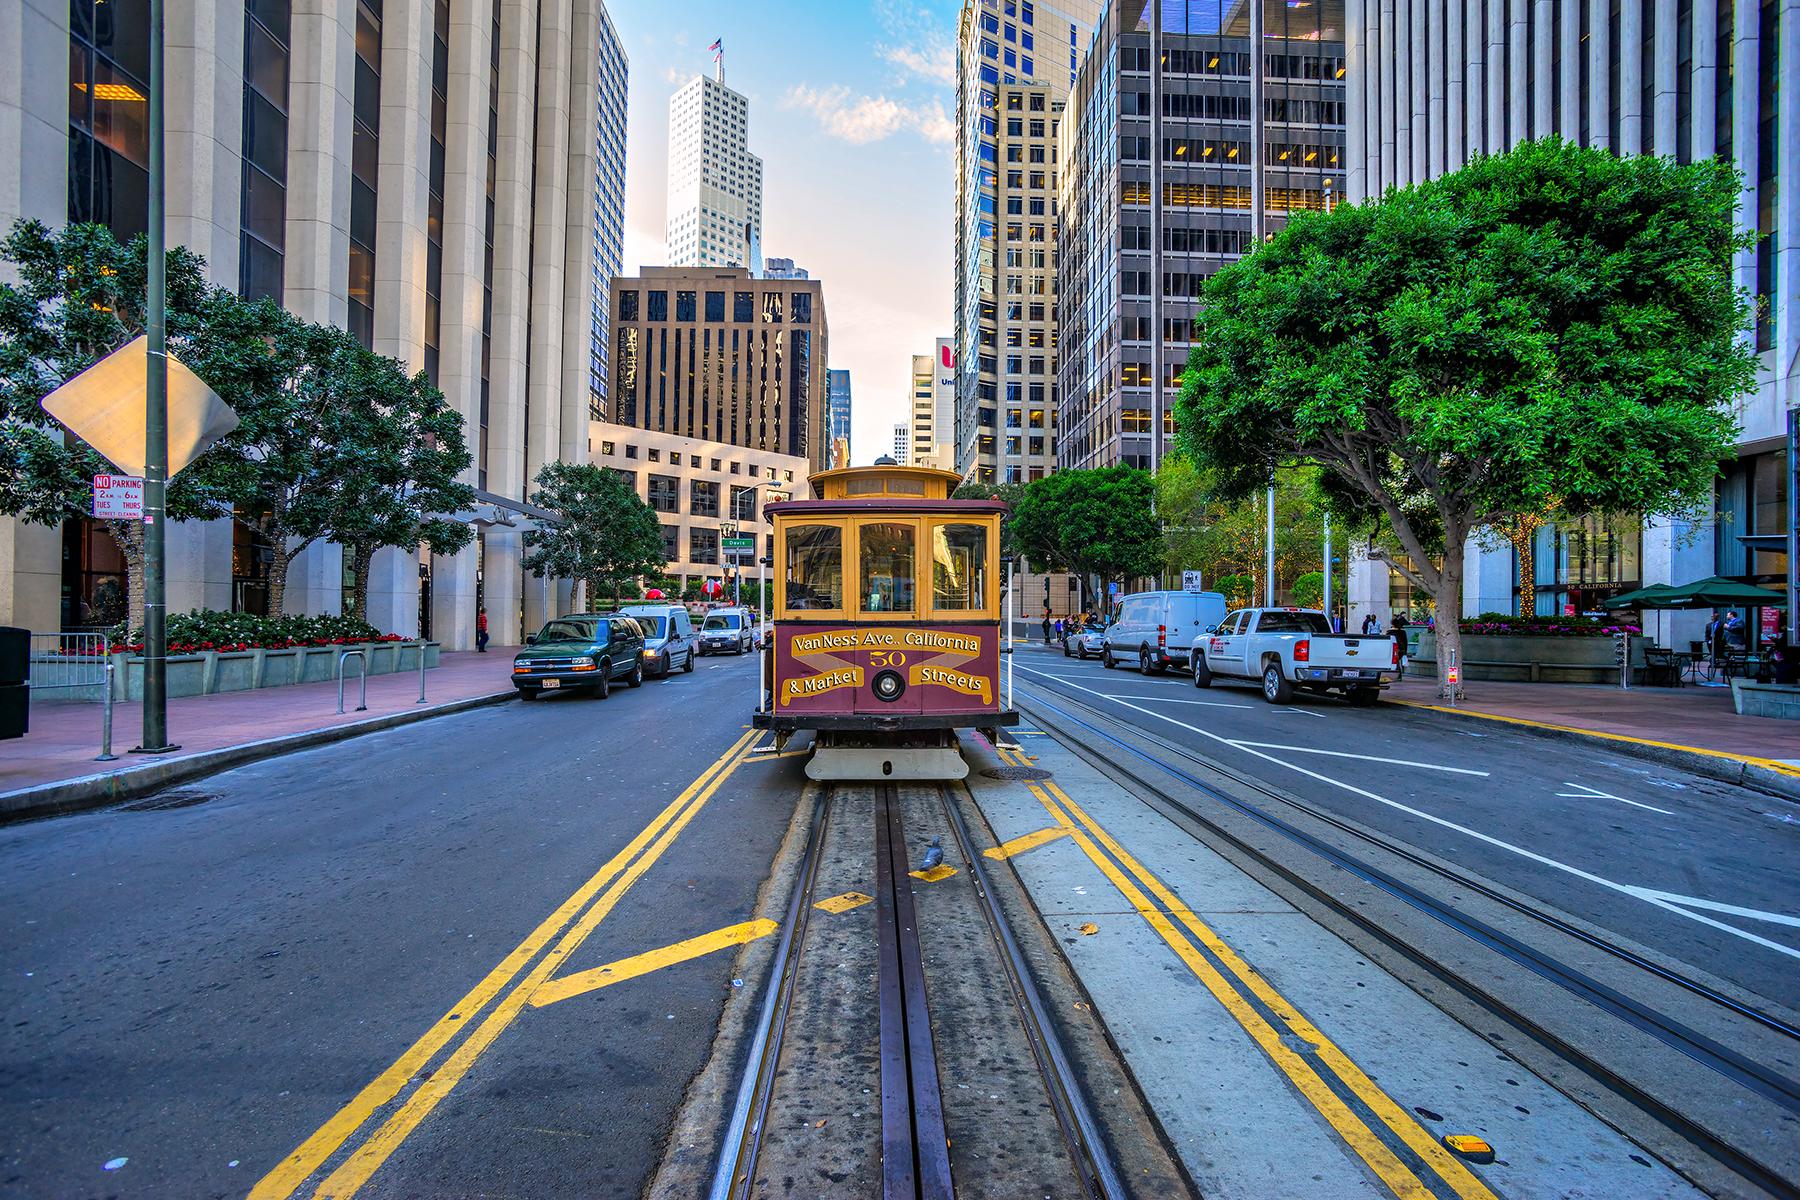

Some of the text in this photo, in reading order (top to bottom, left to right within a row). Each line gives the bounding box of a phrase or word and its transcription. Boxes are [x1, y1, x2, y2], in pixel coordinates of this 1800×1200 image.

[96, 476, 141, 488] NO PARKING
[795, 637, 821, 651] Van
[822, 634, 859, 649] Ness
[905, 632, 978, 652] California
[870, 651, 906, 667] 50
[790, 671, 857, 693] & Market
[921, 668, 982, 690] Streets
